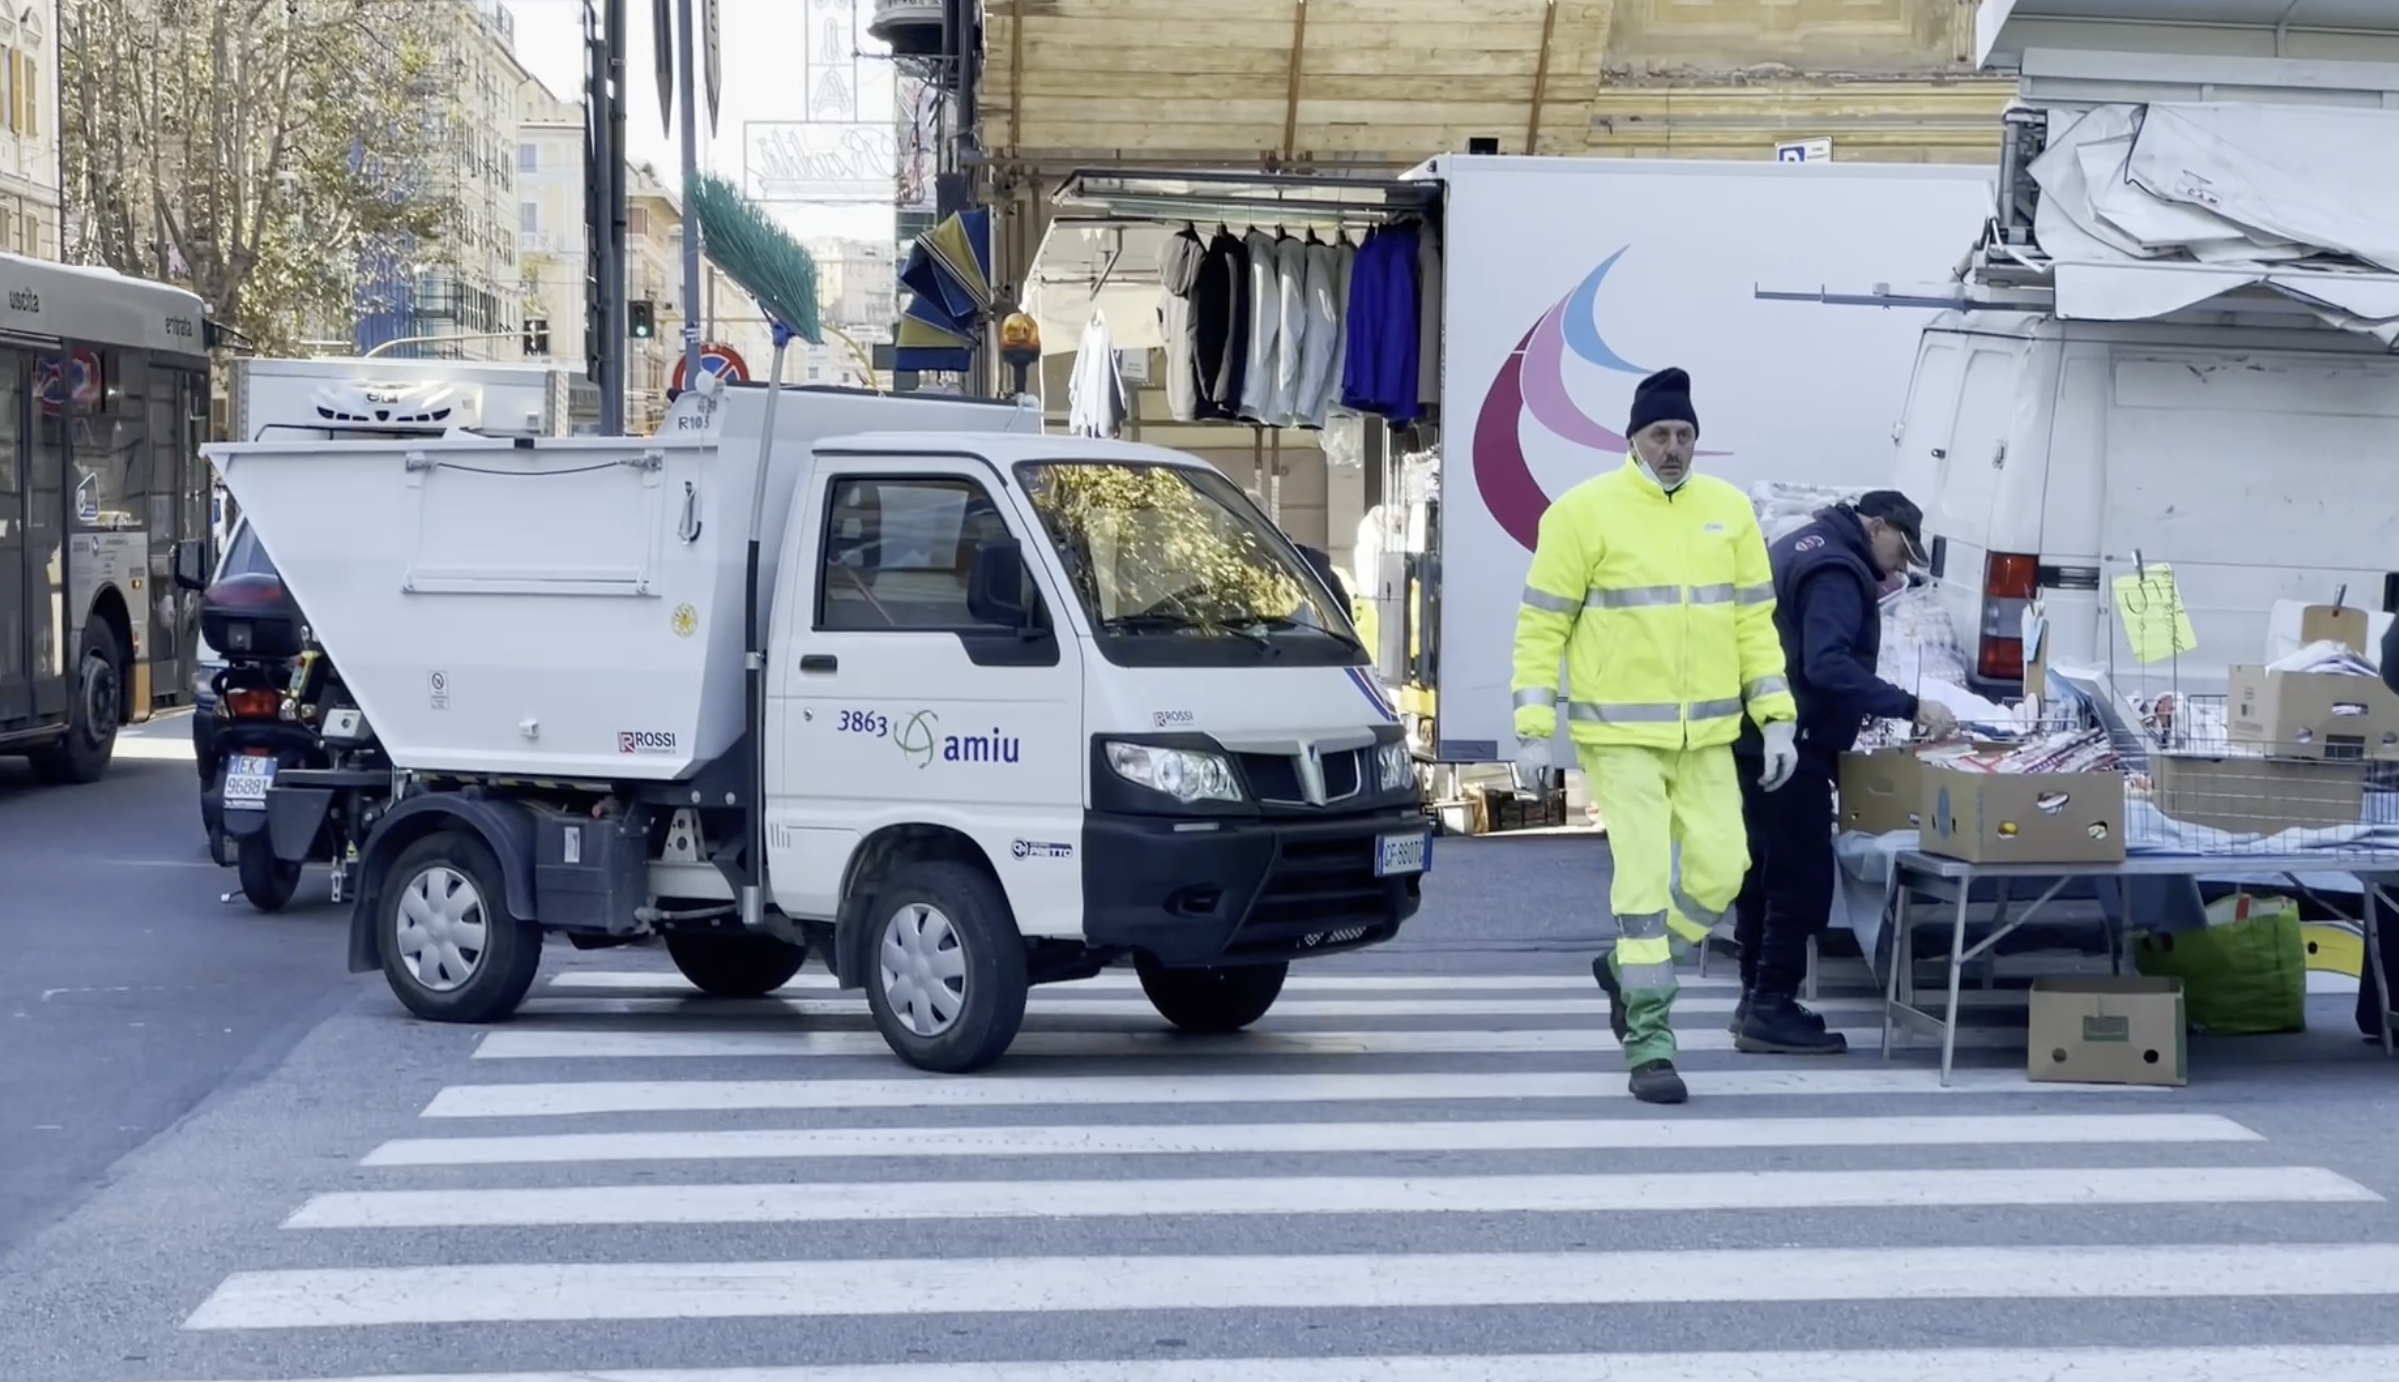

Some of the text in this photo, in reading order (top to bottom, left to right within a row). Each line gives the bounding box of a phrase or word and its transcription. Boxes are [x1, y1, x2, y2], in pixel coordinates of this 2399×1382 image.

[9, 287, 40, 313] uscita
[165, 316, 193, 338] entrata
[837, 709, 888, 737] 3863
[1165, 710, 1194, 721] ROSSI
[635, 731, 676, 747] ROSSI
[943, 726, 1020, 763] amiu
[240, 757, 258, 774] EK
